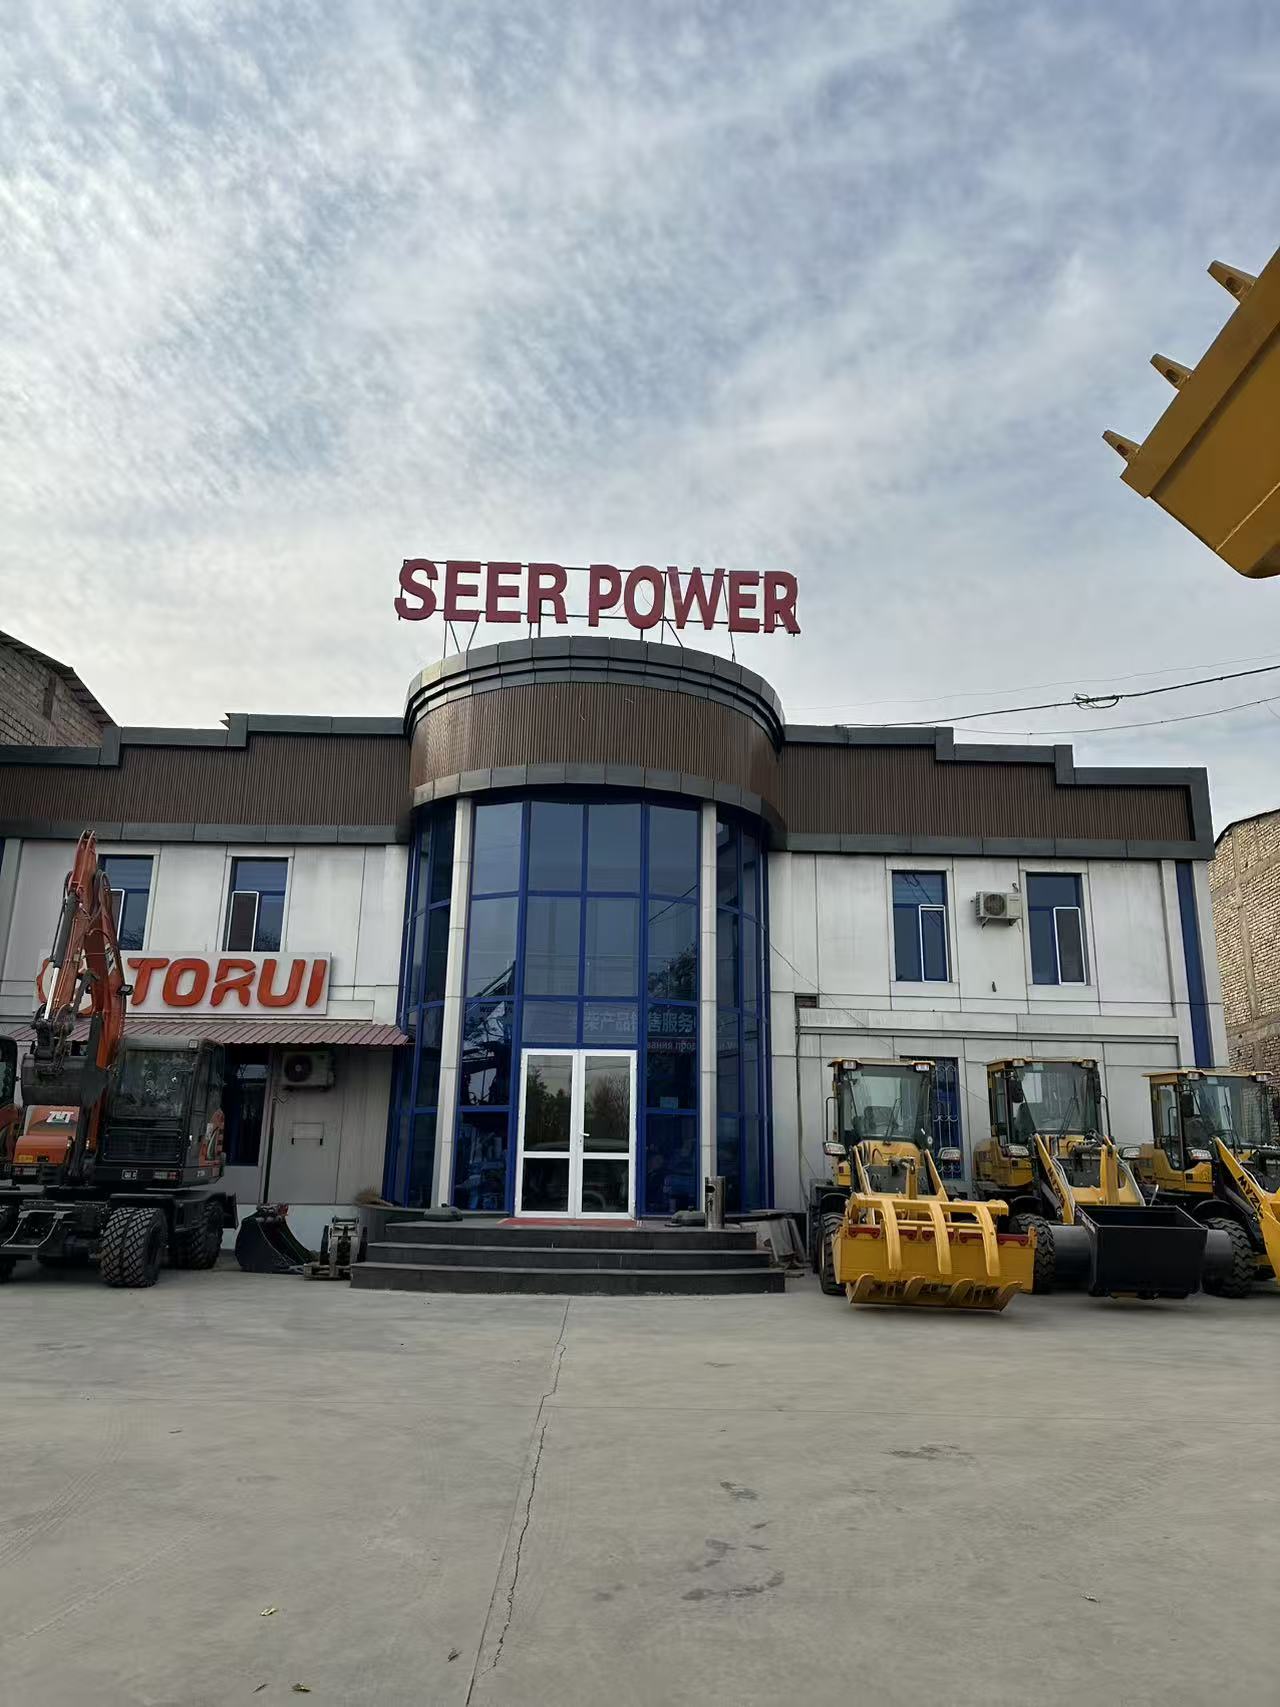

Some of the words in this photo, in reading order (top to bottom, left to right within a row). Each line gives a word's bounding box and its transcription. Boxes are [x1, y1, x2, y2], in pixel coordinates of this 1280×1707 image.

[394, 558, 568, 624] SEER
[588, 564, 801, 634] POWER
[127, 957, 328, 1008] TORUI
